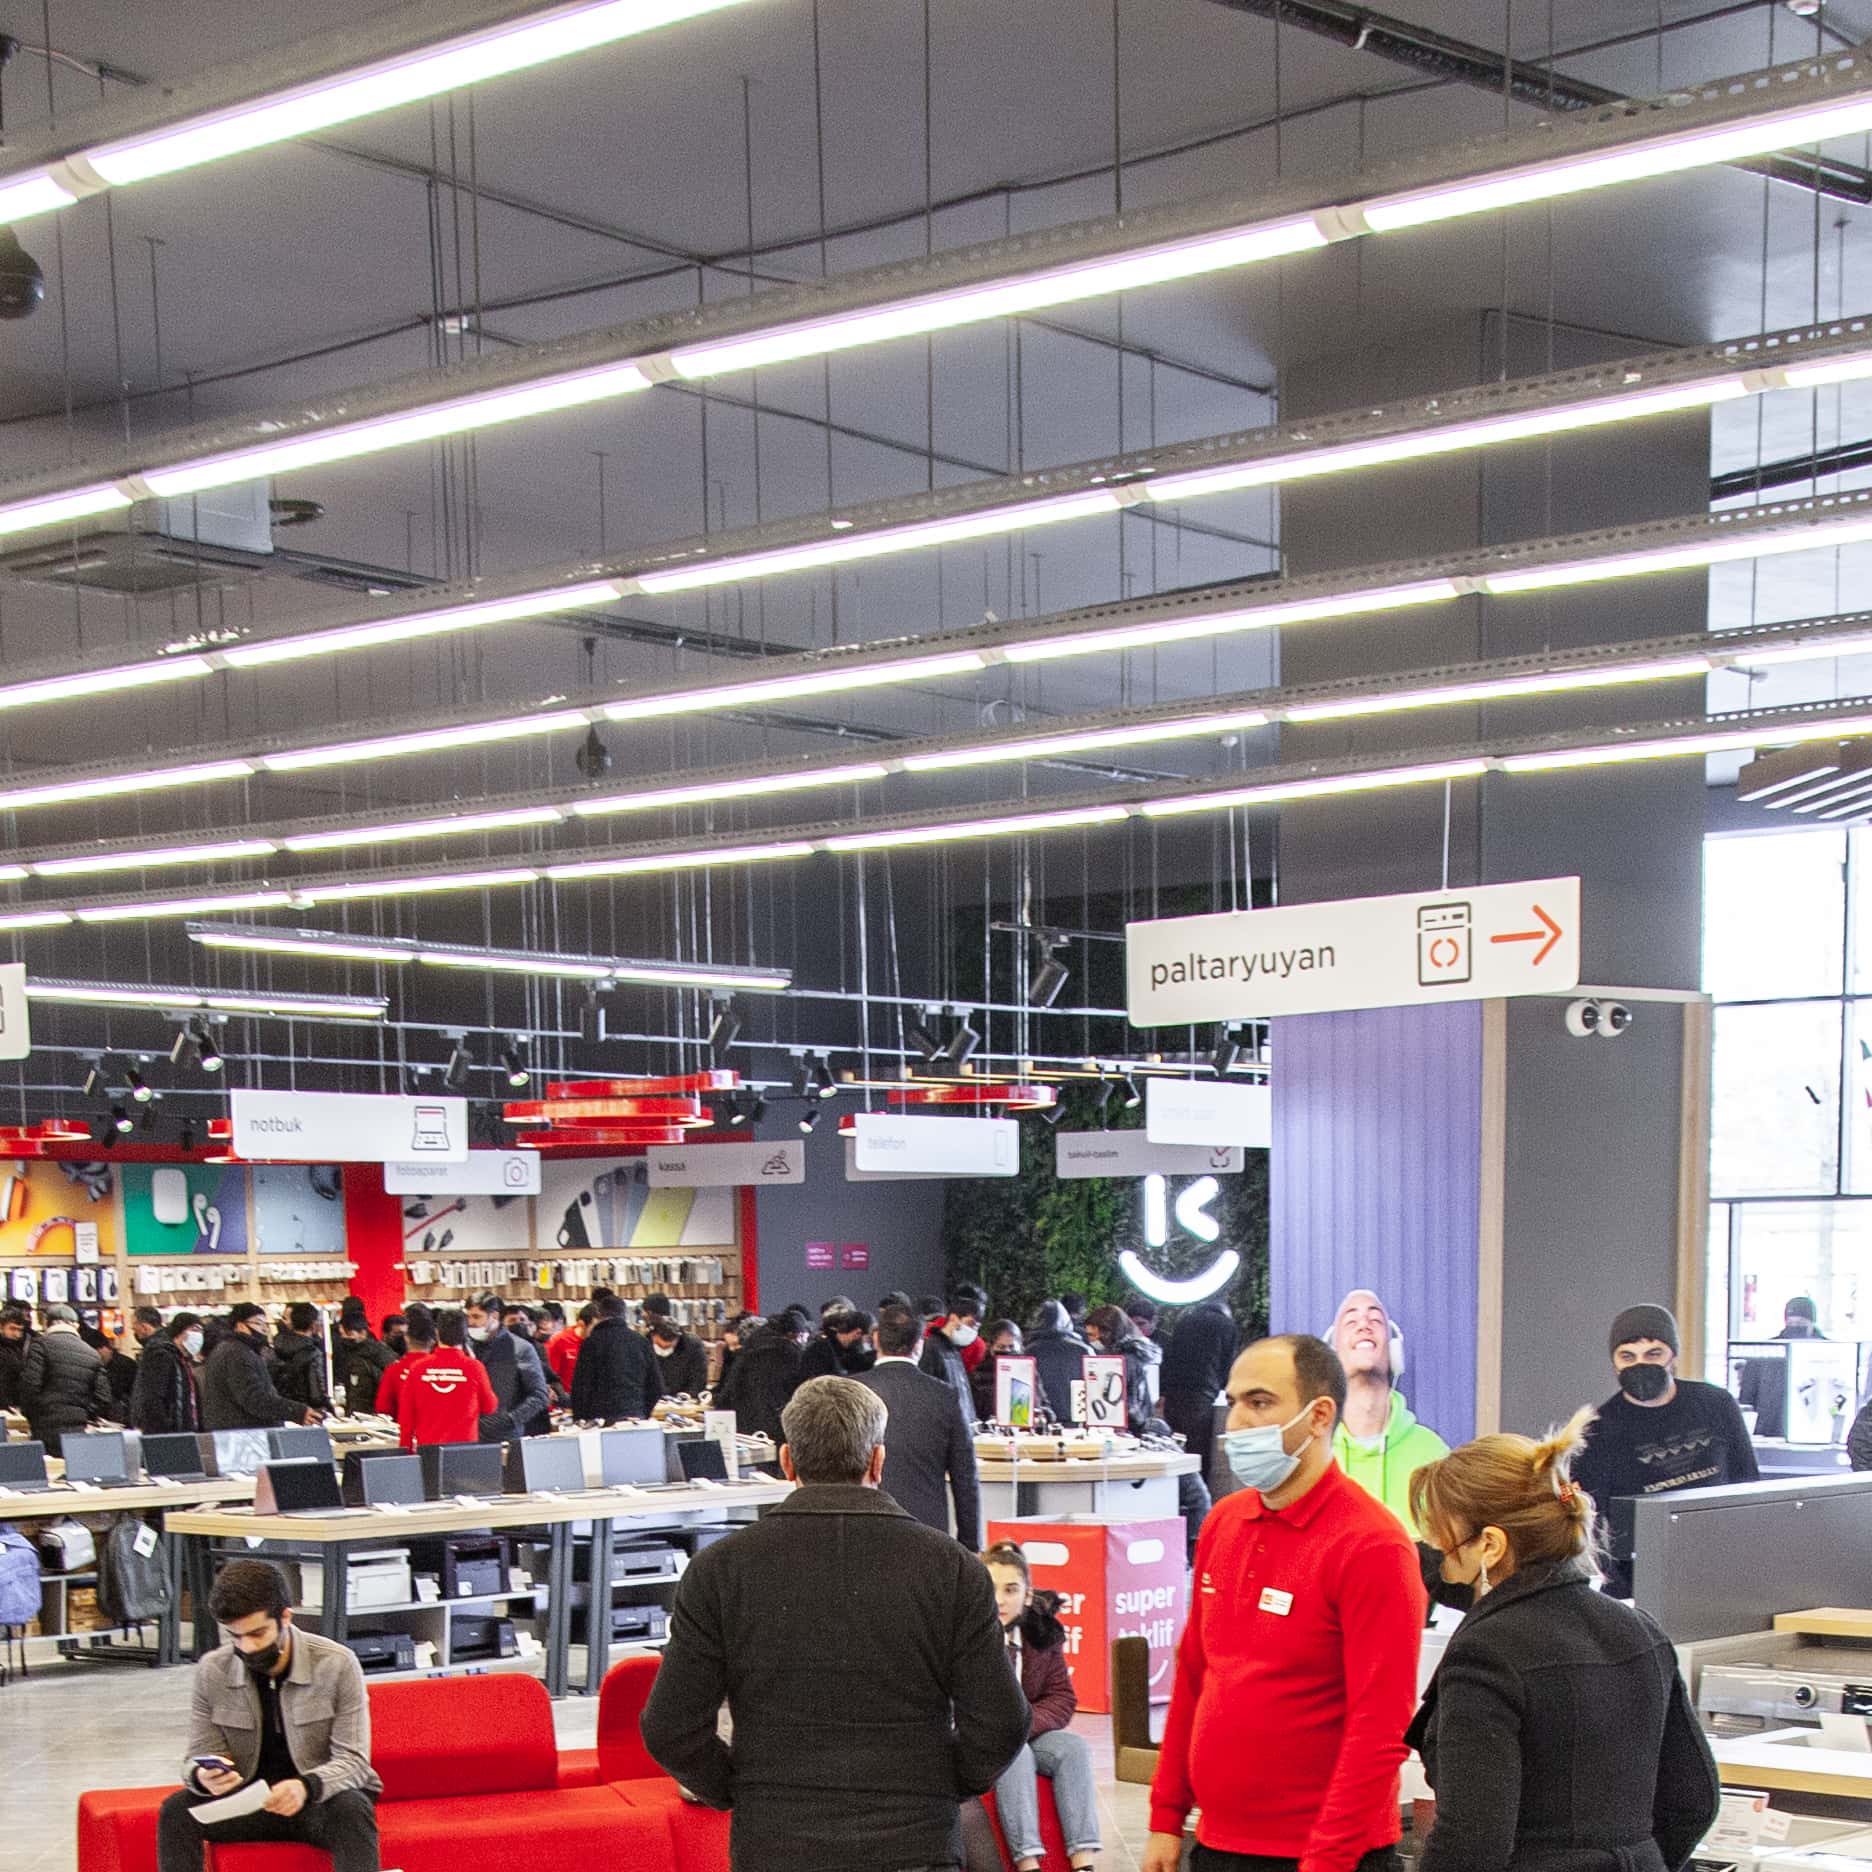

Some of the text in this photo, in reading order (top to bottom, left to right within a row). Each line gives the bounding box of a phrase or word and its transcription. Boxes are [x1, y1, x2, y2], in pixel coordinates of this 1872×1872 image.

[1150, 944, 1336, 992] paltaryuyan
[249, 1116, 303, 1133] notbuk
[1115, 1586, 1177, 1616] super
